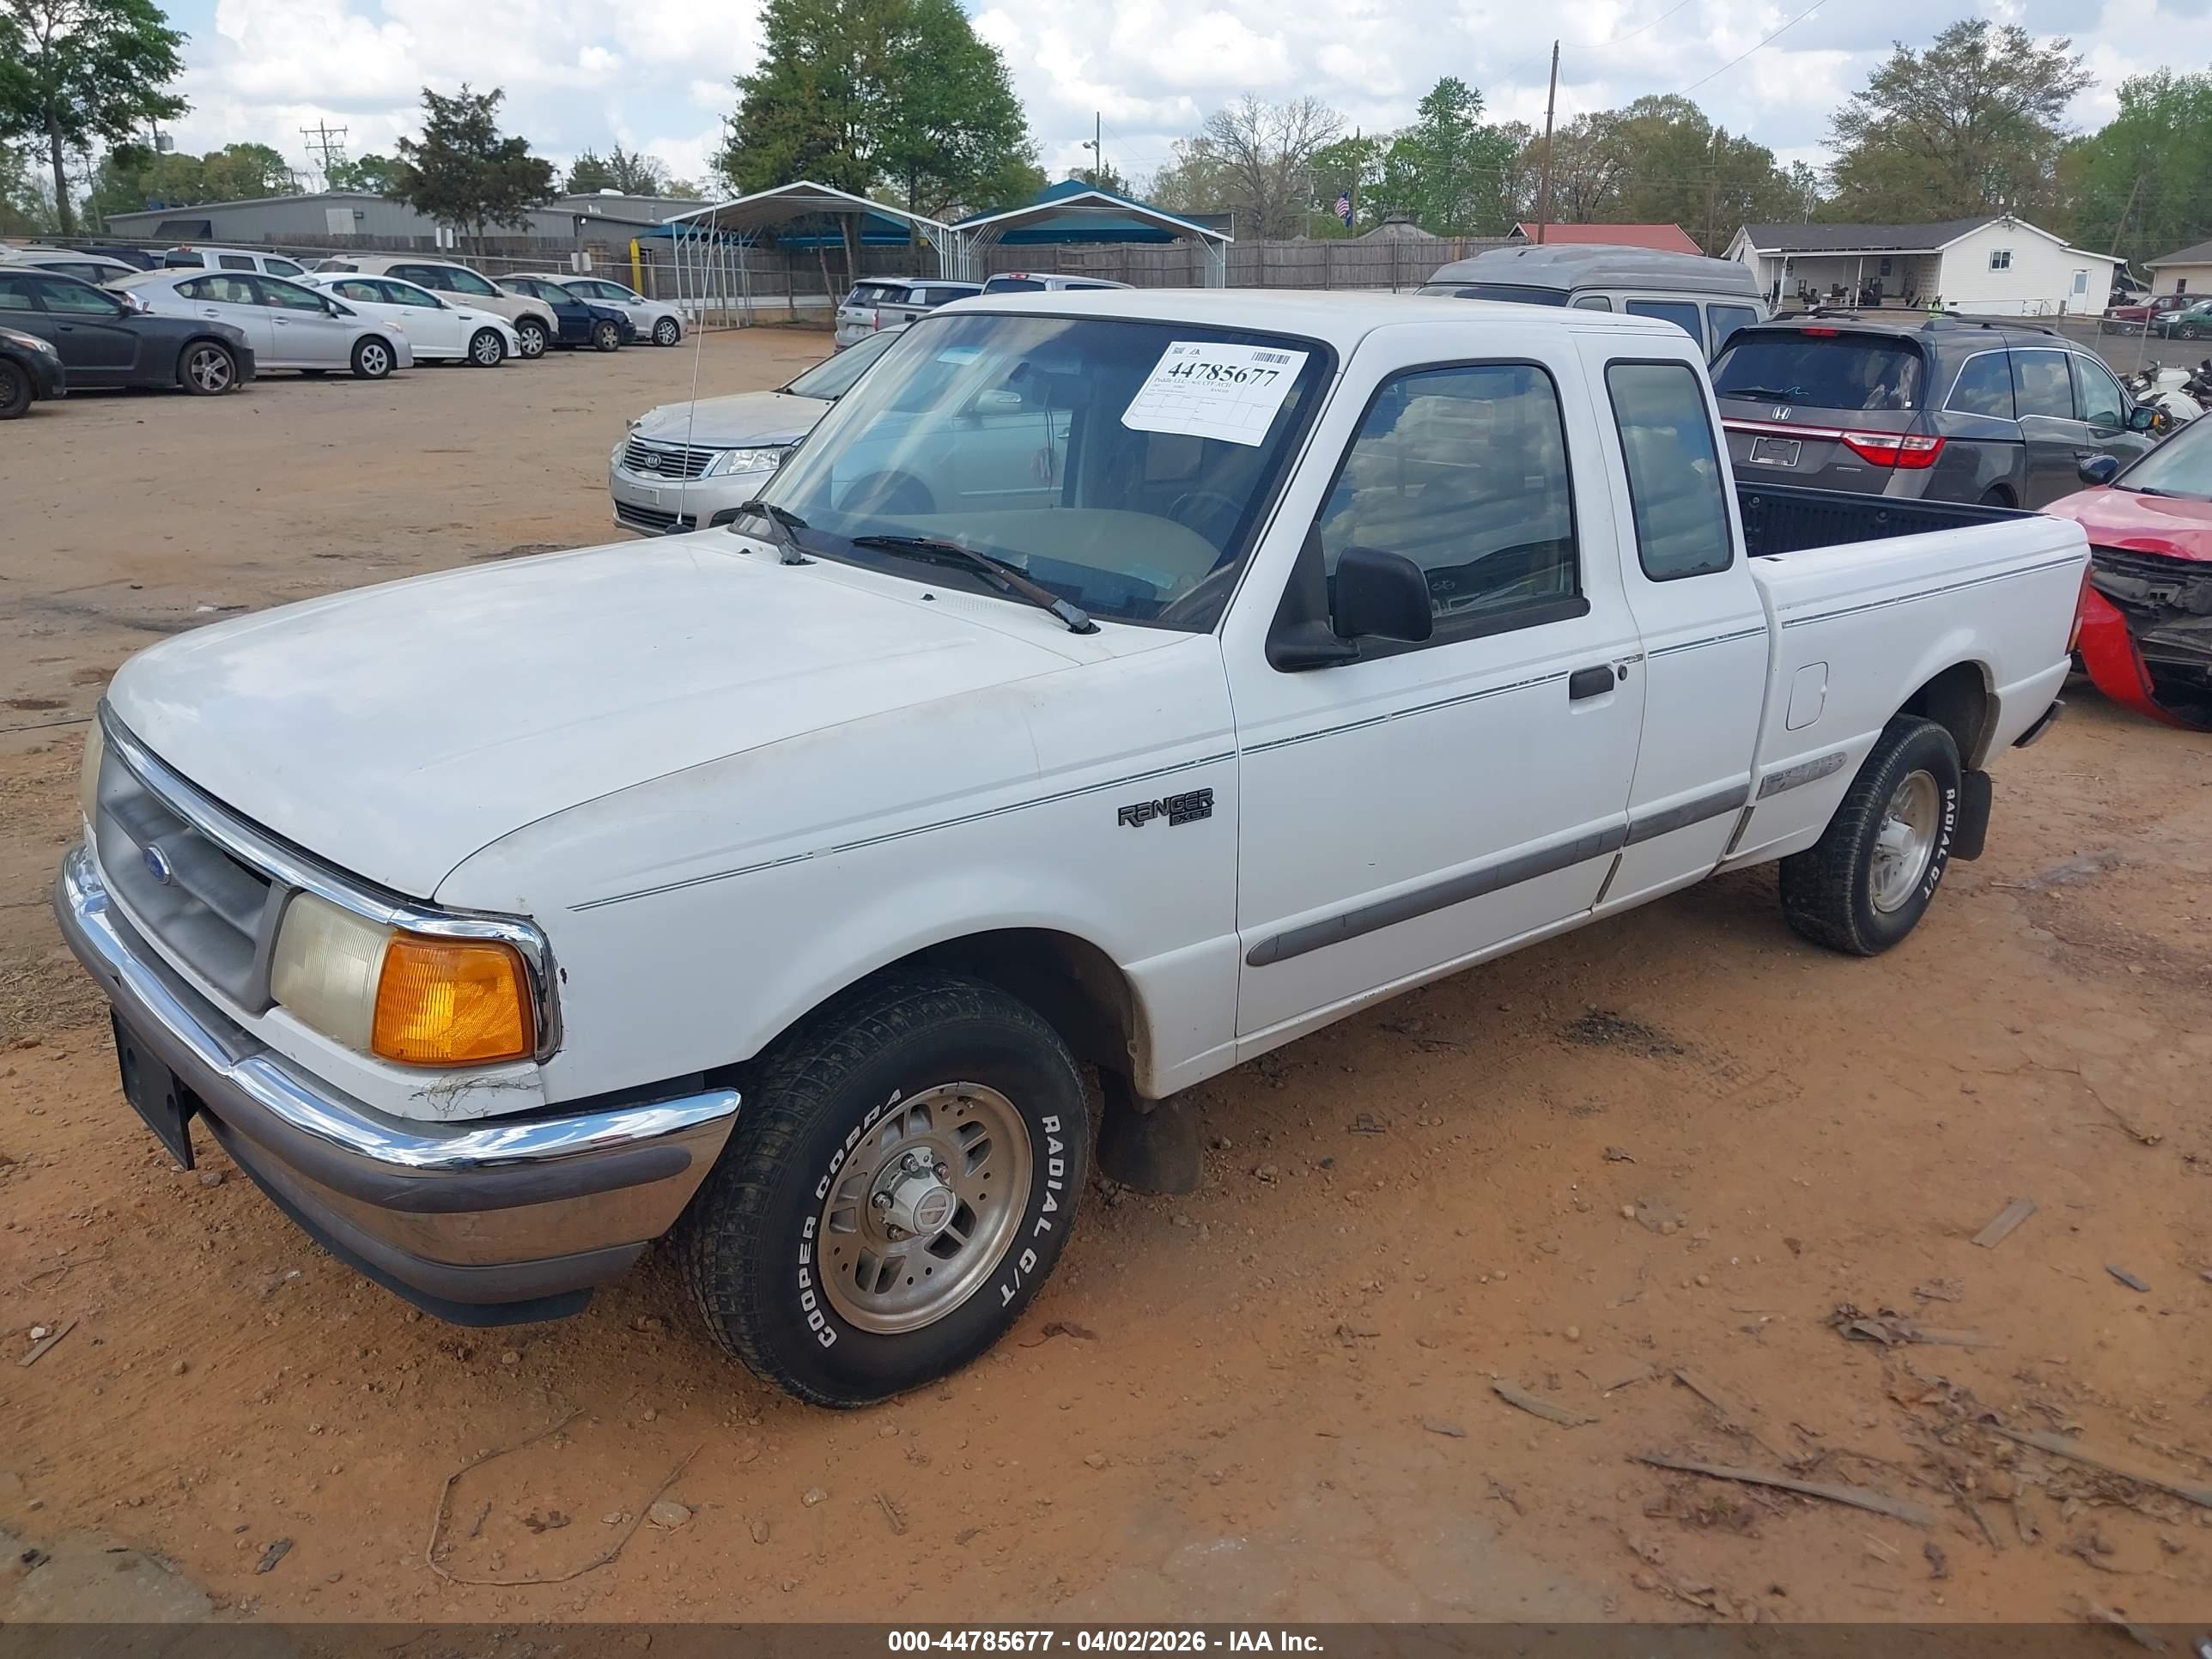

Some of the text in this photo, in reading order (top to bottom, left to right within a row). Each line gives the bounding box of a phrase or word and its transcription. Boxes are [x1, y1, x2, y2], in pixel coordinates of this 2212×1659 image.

[1168, 362, 1280, 387] 44785677
[1118, 787, 1215, 827] RANGER
[1937, 787, 1956, 860] RADIAL
[798, 1088, 903, 1349] COOPER COBRA
[1000, 1114, 1065, 1308] RADIAL G/T
